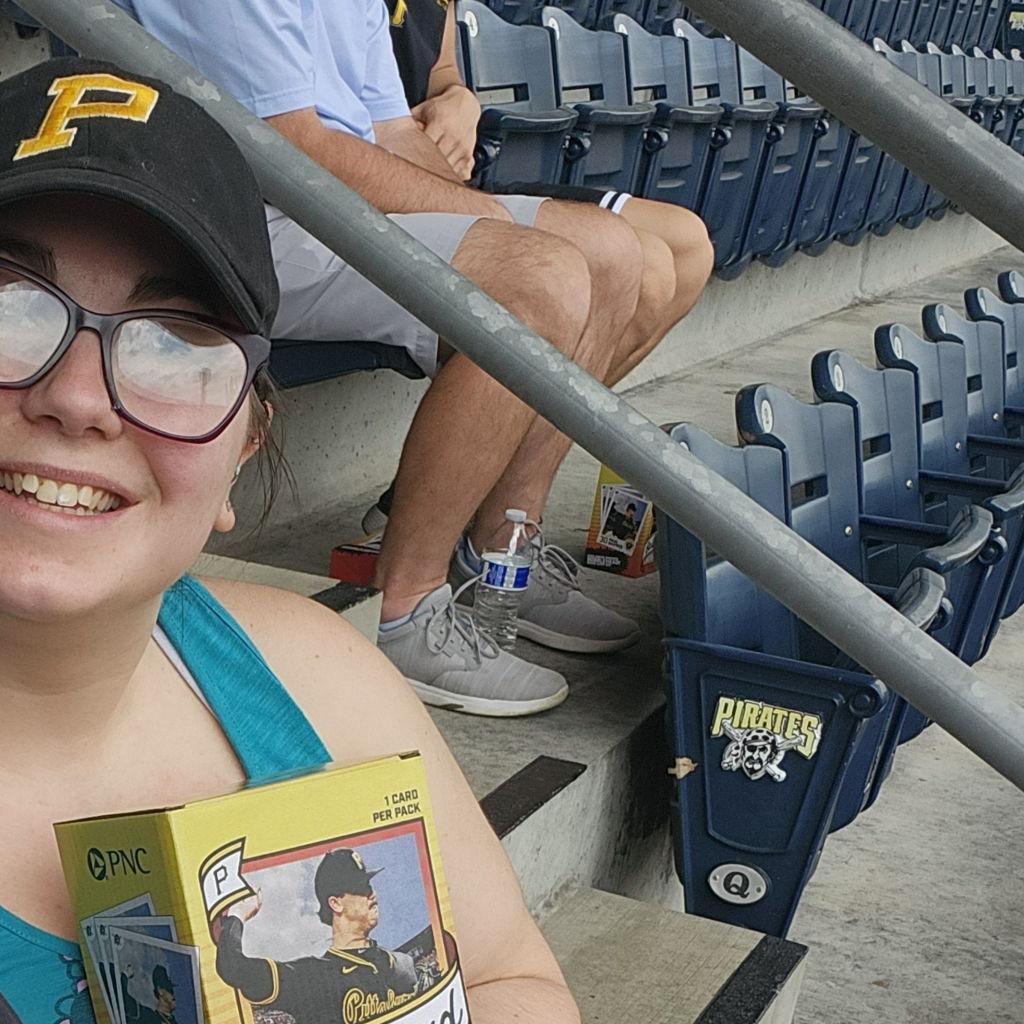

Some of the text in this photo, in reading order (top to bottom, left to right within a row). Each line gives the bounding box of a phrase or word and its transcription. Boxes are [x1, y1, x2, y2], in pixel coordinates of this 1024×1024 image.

[13, 73, 160, 161] P
[710, 696, 822, 759] PIRATES
[384, 789, 419, 807] 1 CARD
[372, 802, 421, 823] PER PACK
[107, 848, 151, 876] PNC
[213, 865, 229, 896] P
[723, 871, 750, 899] Q
